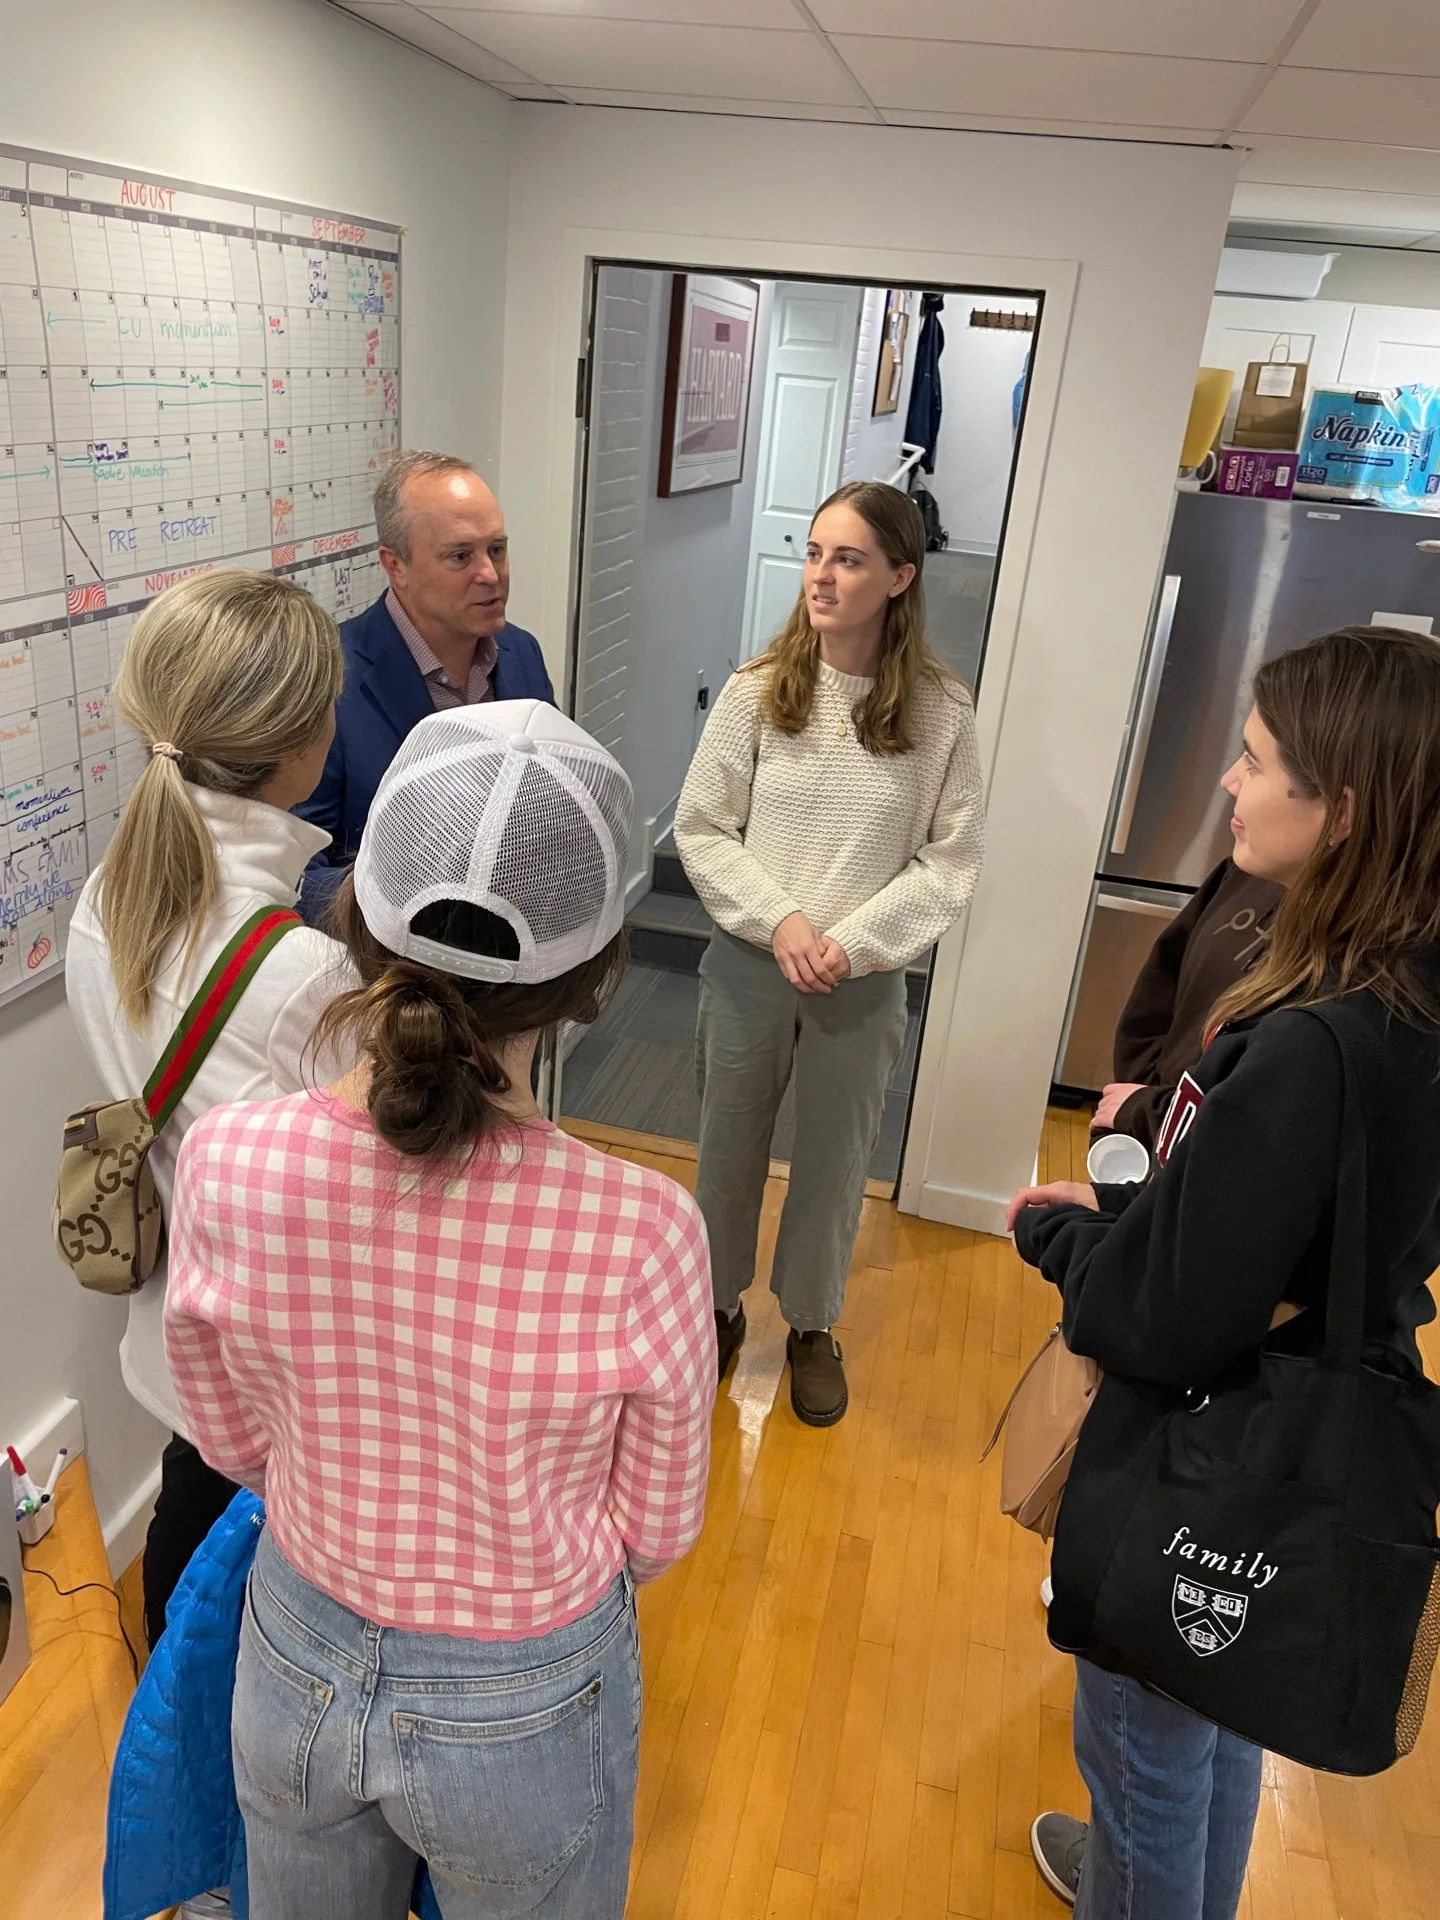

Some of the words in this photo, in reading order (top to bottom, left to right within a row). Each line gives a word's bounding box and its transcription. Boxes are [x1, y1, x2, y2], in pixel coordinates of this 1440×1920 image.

[121, 180, 176, 212] AUGUST
[21, 204, 27, 217] 5
[311, 217, 366, 244] SEPTEMBER
[1241, 460, 1255, 488] Forks
[108, 528, 139, 554] PRE
[160, 516, 217, 544] RETREAT
[313, 531, 360, 555] DECEMBER
[16, 803, 71, 832] conference
[1162, 1526, 1279, 1588] family
